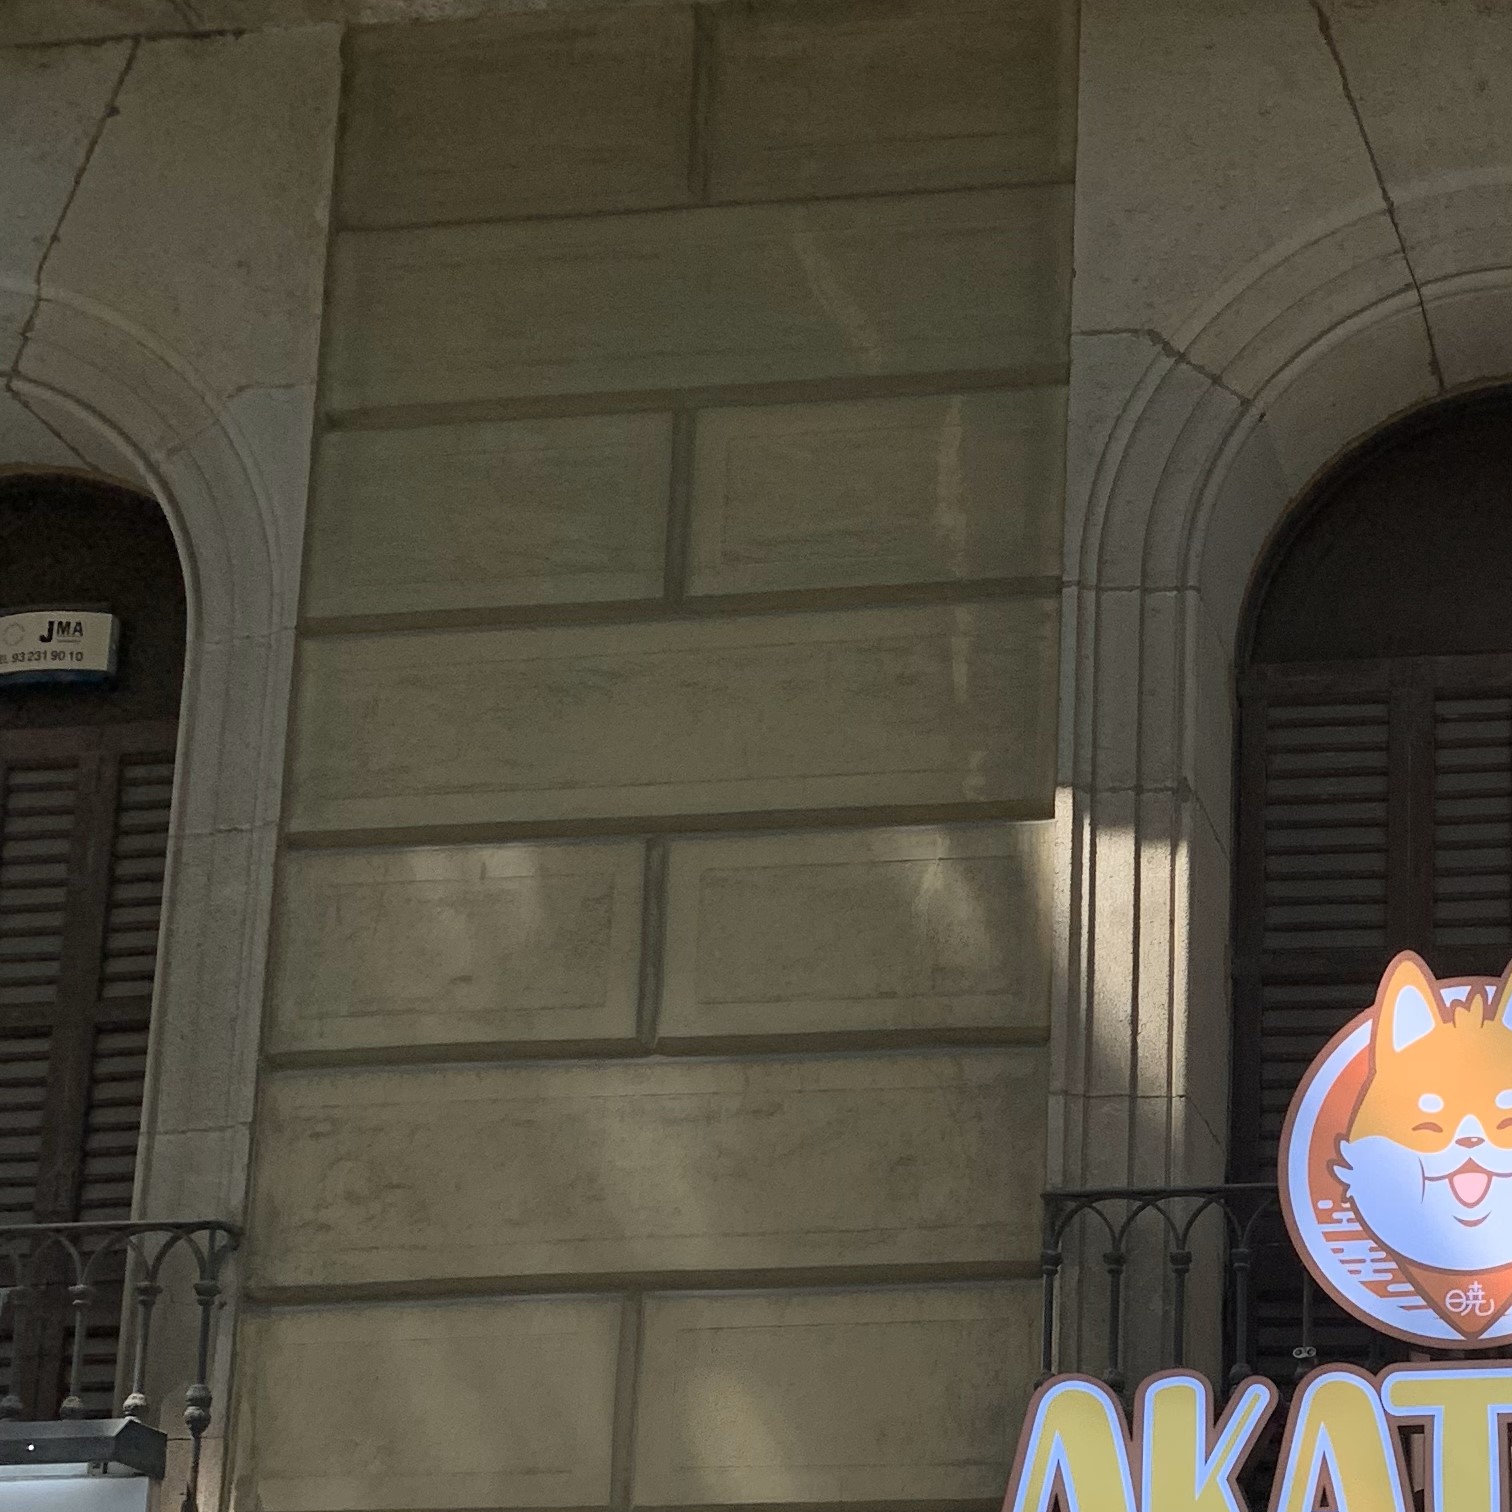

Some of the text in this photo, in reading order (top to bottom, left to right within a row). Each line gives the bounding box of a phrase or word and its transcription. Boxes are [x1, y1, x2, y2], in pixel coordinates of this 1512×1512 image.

[39, 620, 84, 643] JMA
[11, 651, 26, 663] 93
[27, 650, 48, 662] 231
[50, 650, 66, 662] 90
[68, 650, 84, 662] 10
